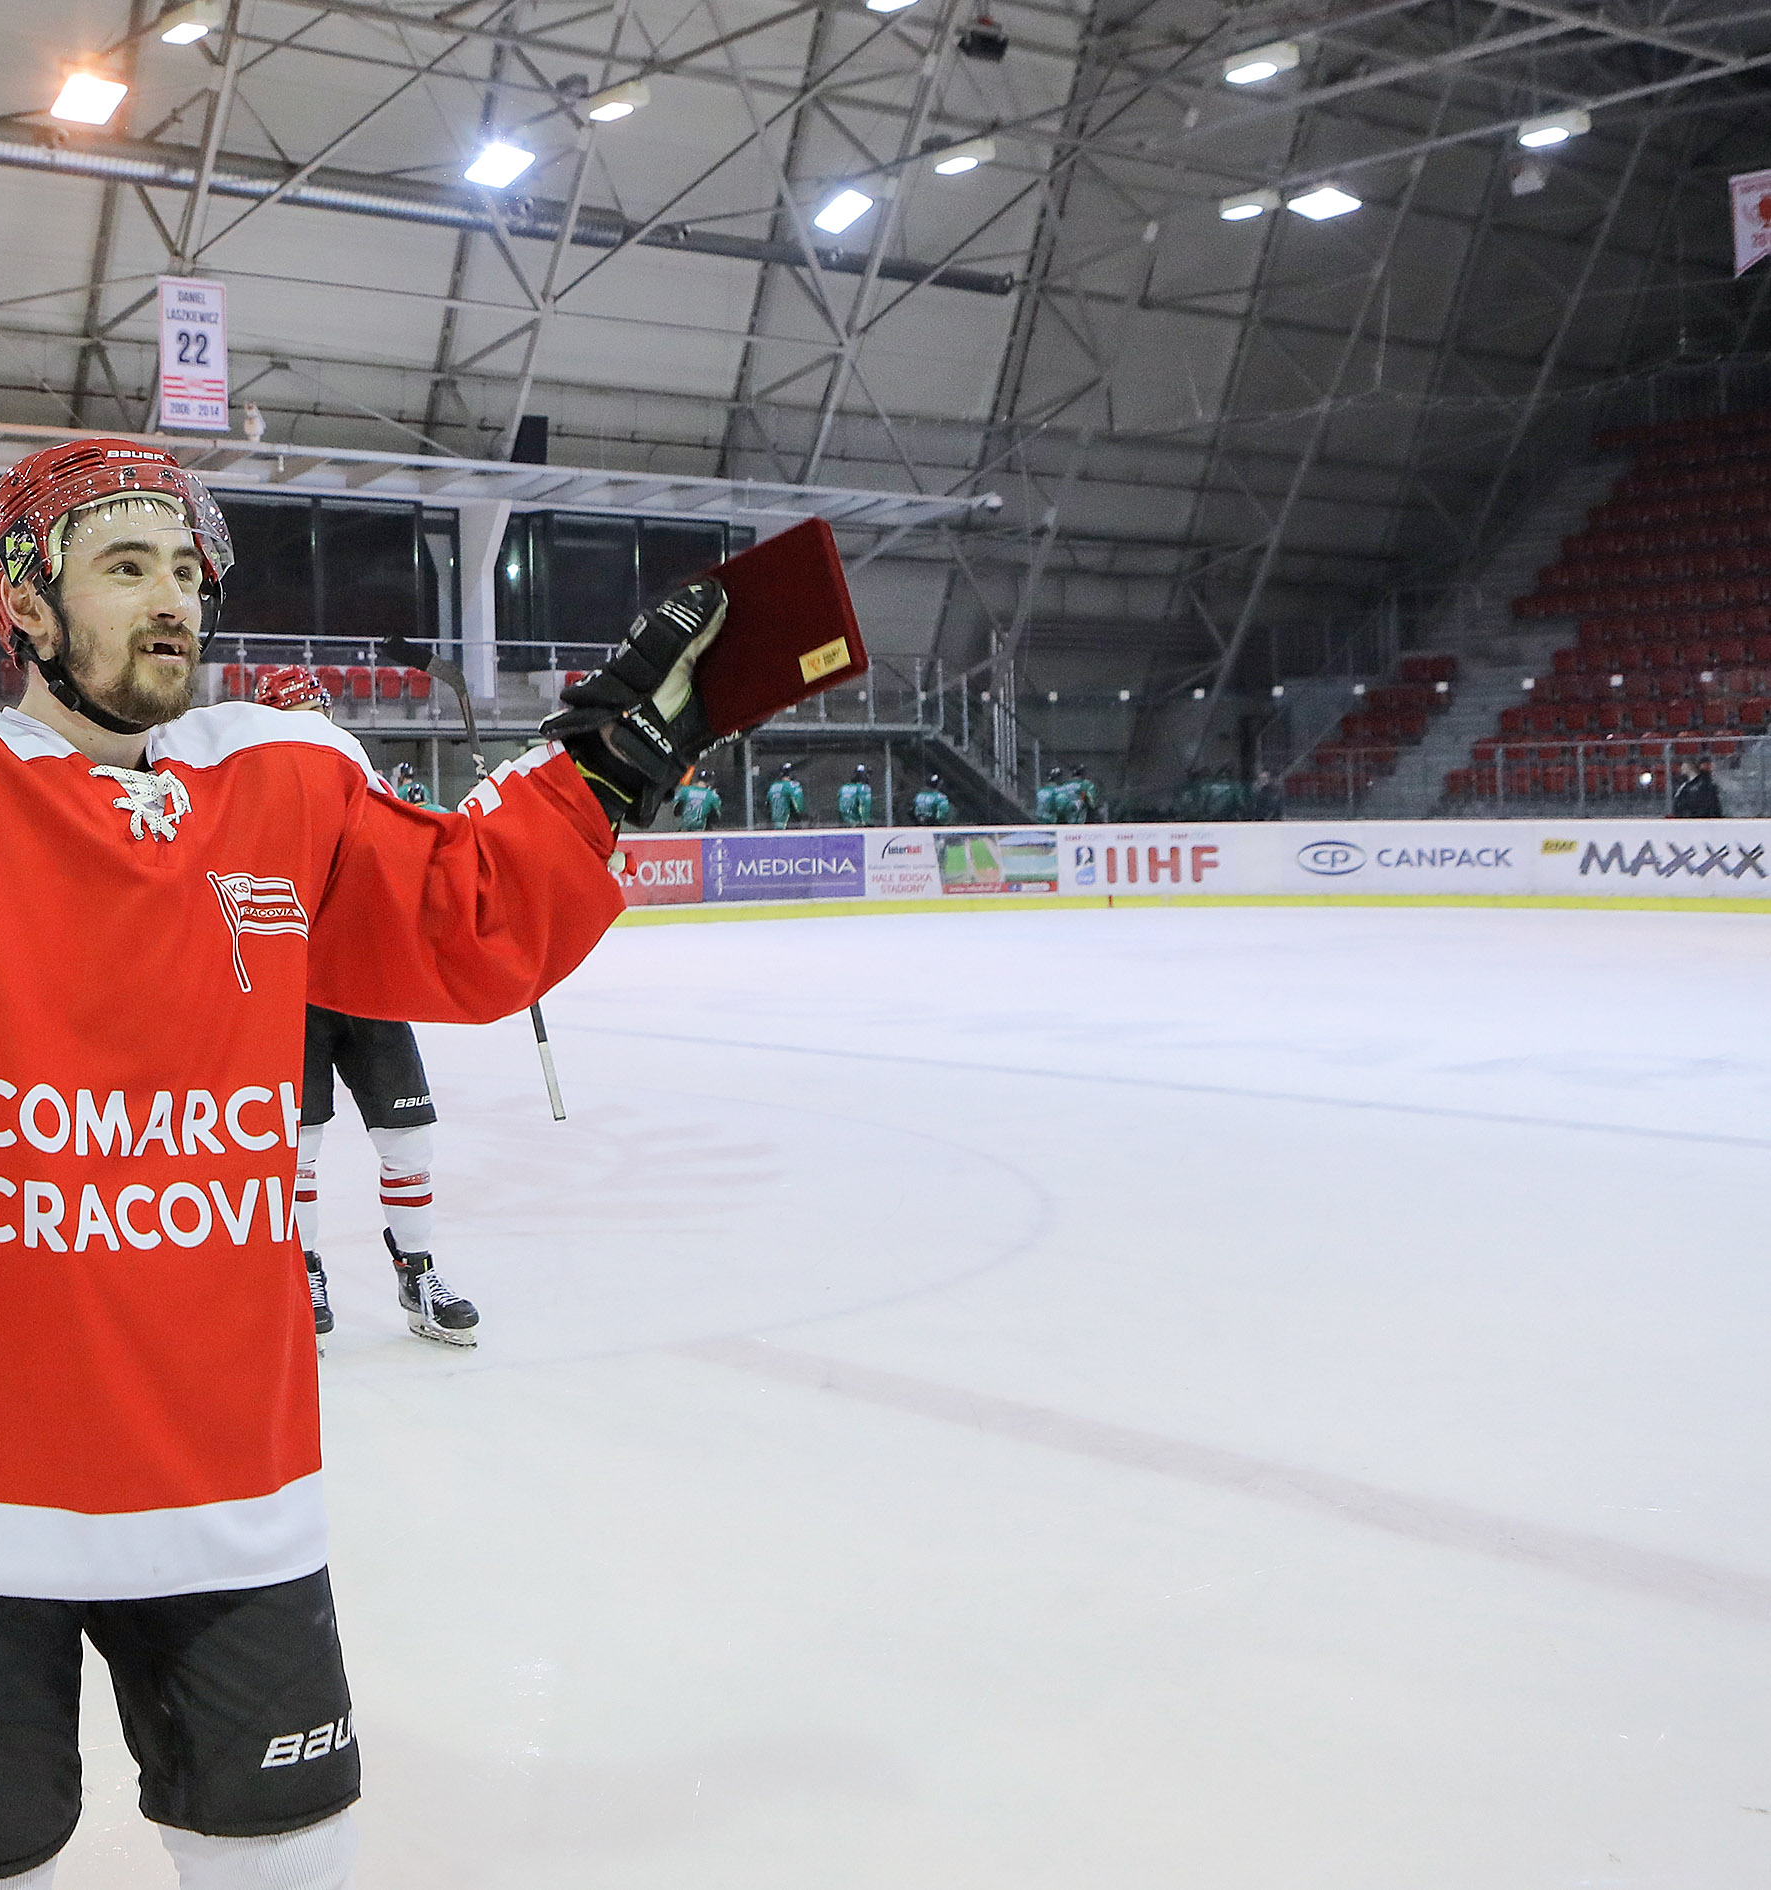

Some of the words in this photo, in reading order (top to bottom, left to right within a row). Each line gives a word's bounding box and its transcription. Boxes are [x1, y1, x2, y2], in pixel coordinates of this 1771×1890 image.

[177, 289, 206, 305] DANIEL
[176, 328, 210, 367] 22
[106, 449, 165, 462] BAUER
[630, 711, 674, 756] CCM
[736, 857, 857, 877] MEDICINA
[1106, 846, 1220, 883] IIHF
[1377, 848, 1513, 868] CANPACK
[1579, 839, 1769, 879] MAXXX
[623, 860, 694, 888] OLSKI
[229, 881, 249, 894] KS
[393, 1095, 431, 1109] BAUE
[260, 1709, 355, 1769] BAU
